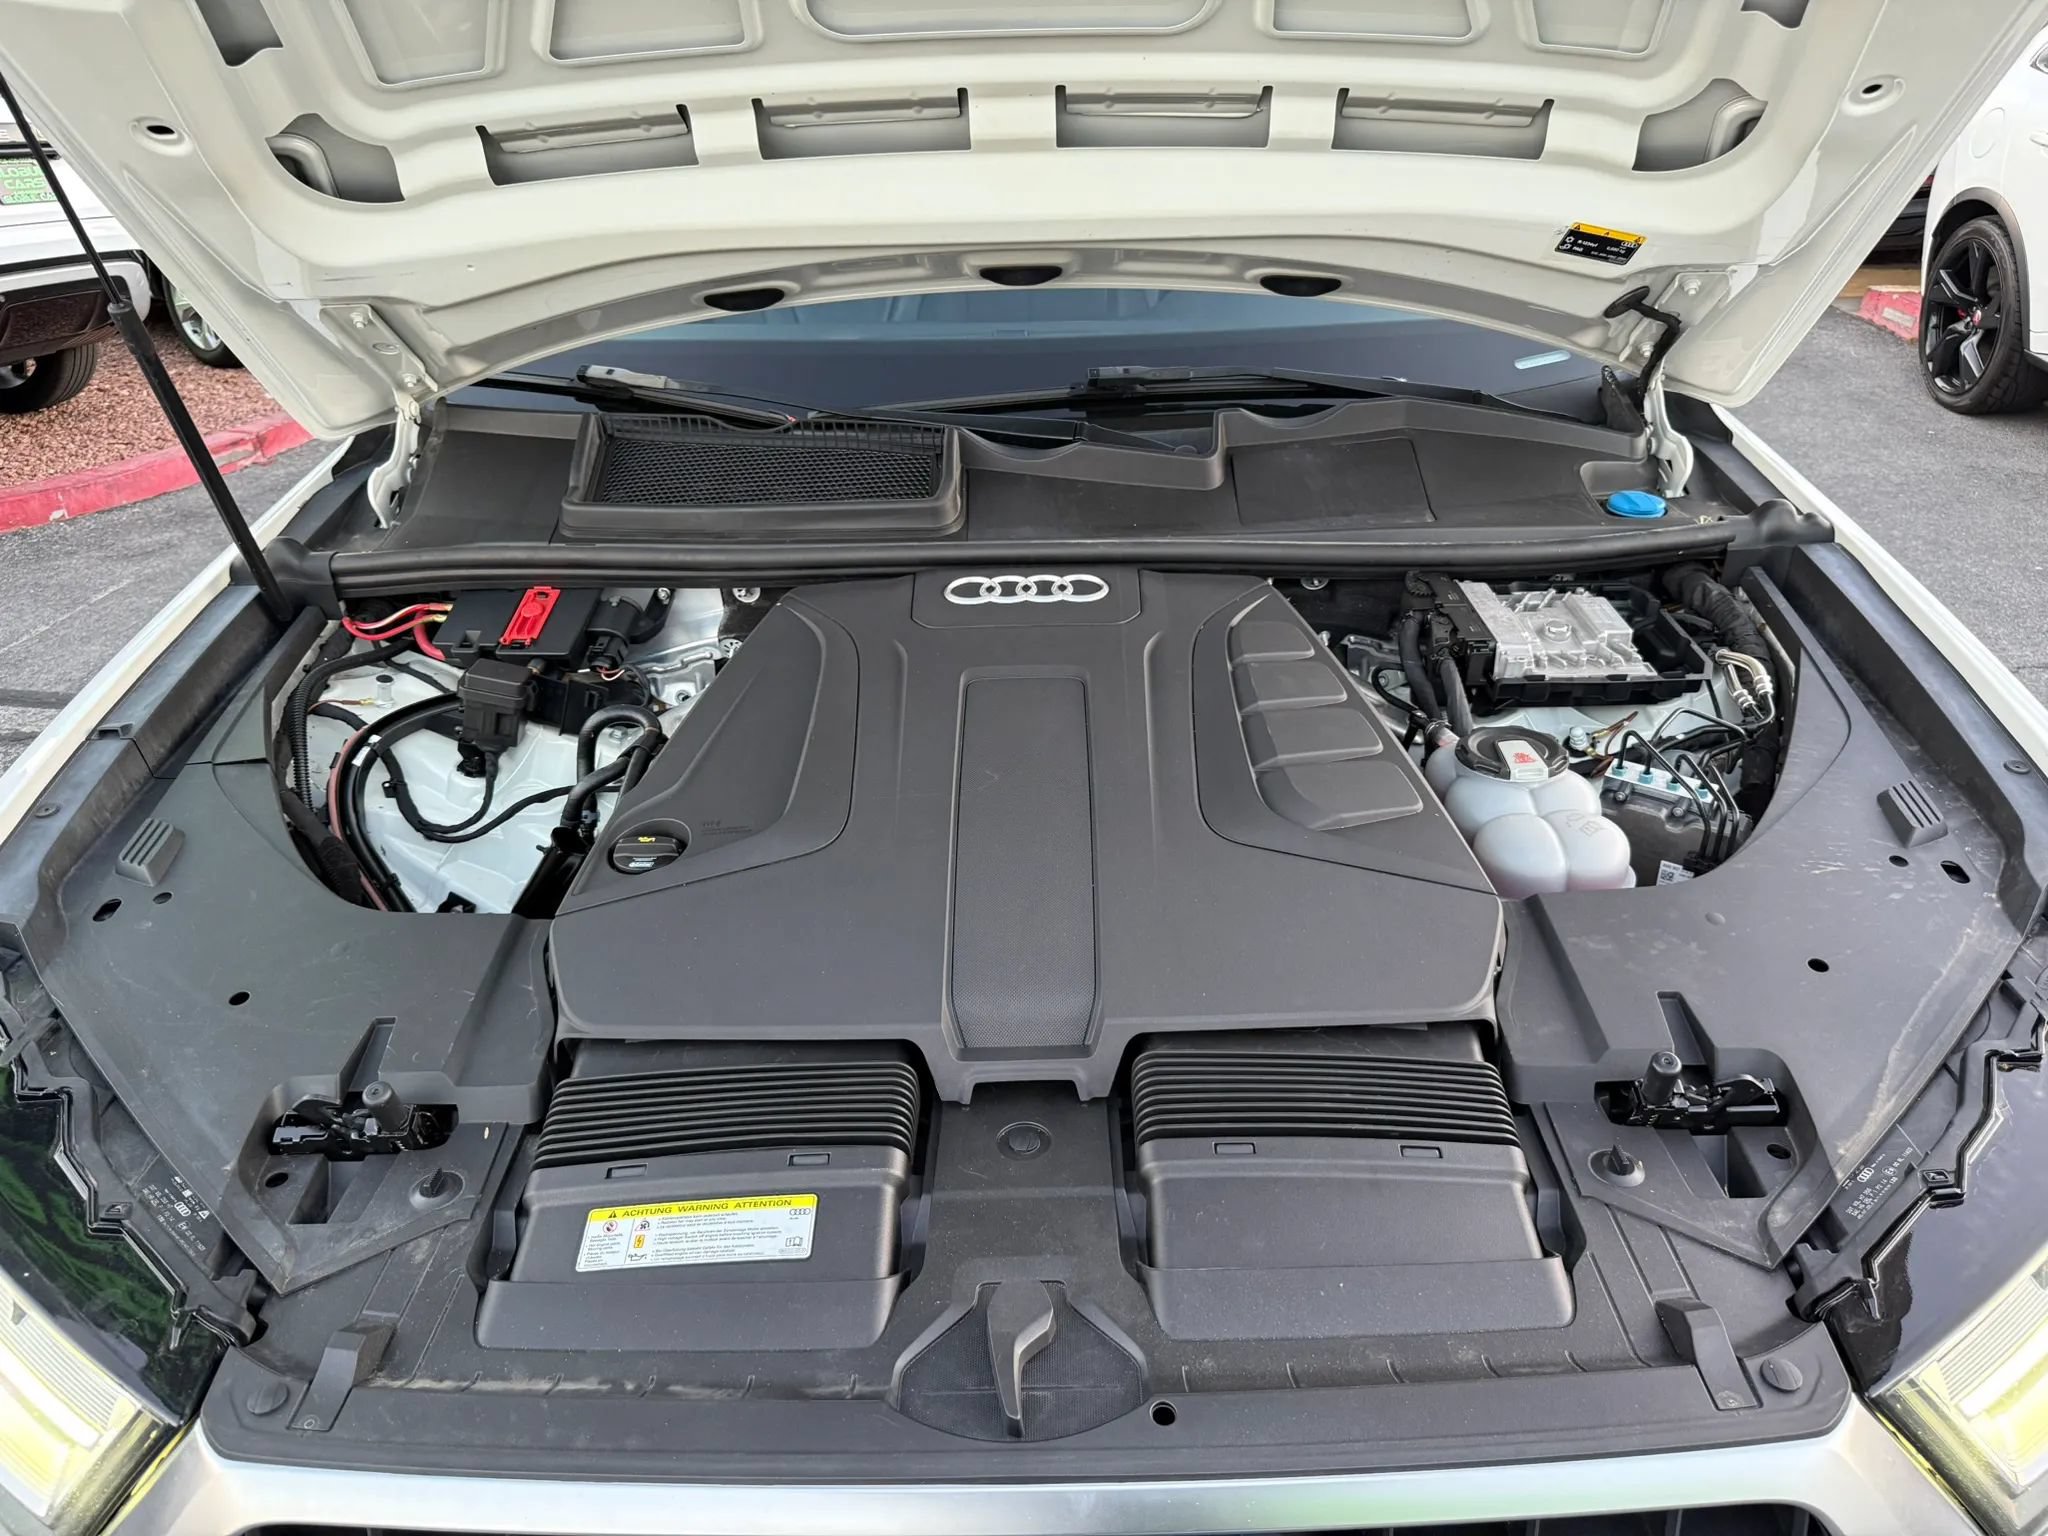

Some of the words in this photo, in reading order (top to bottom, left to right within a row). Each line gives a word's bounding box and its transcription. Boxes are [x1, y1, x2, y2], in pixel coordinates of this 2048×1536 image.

[4, 178, 47, 189] CARS
[622, 1206, 672, 1218] ACHTUNG
[678, 1202, 729, 1213] WARNING
[734, 1198, 792, 1209] ATTENTION
